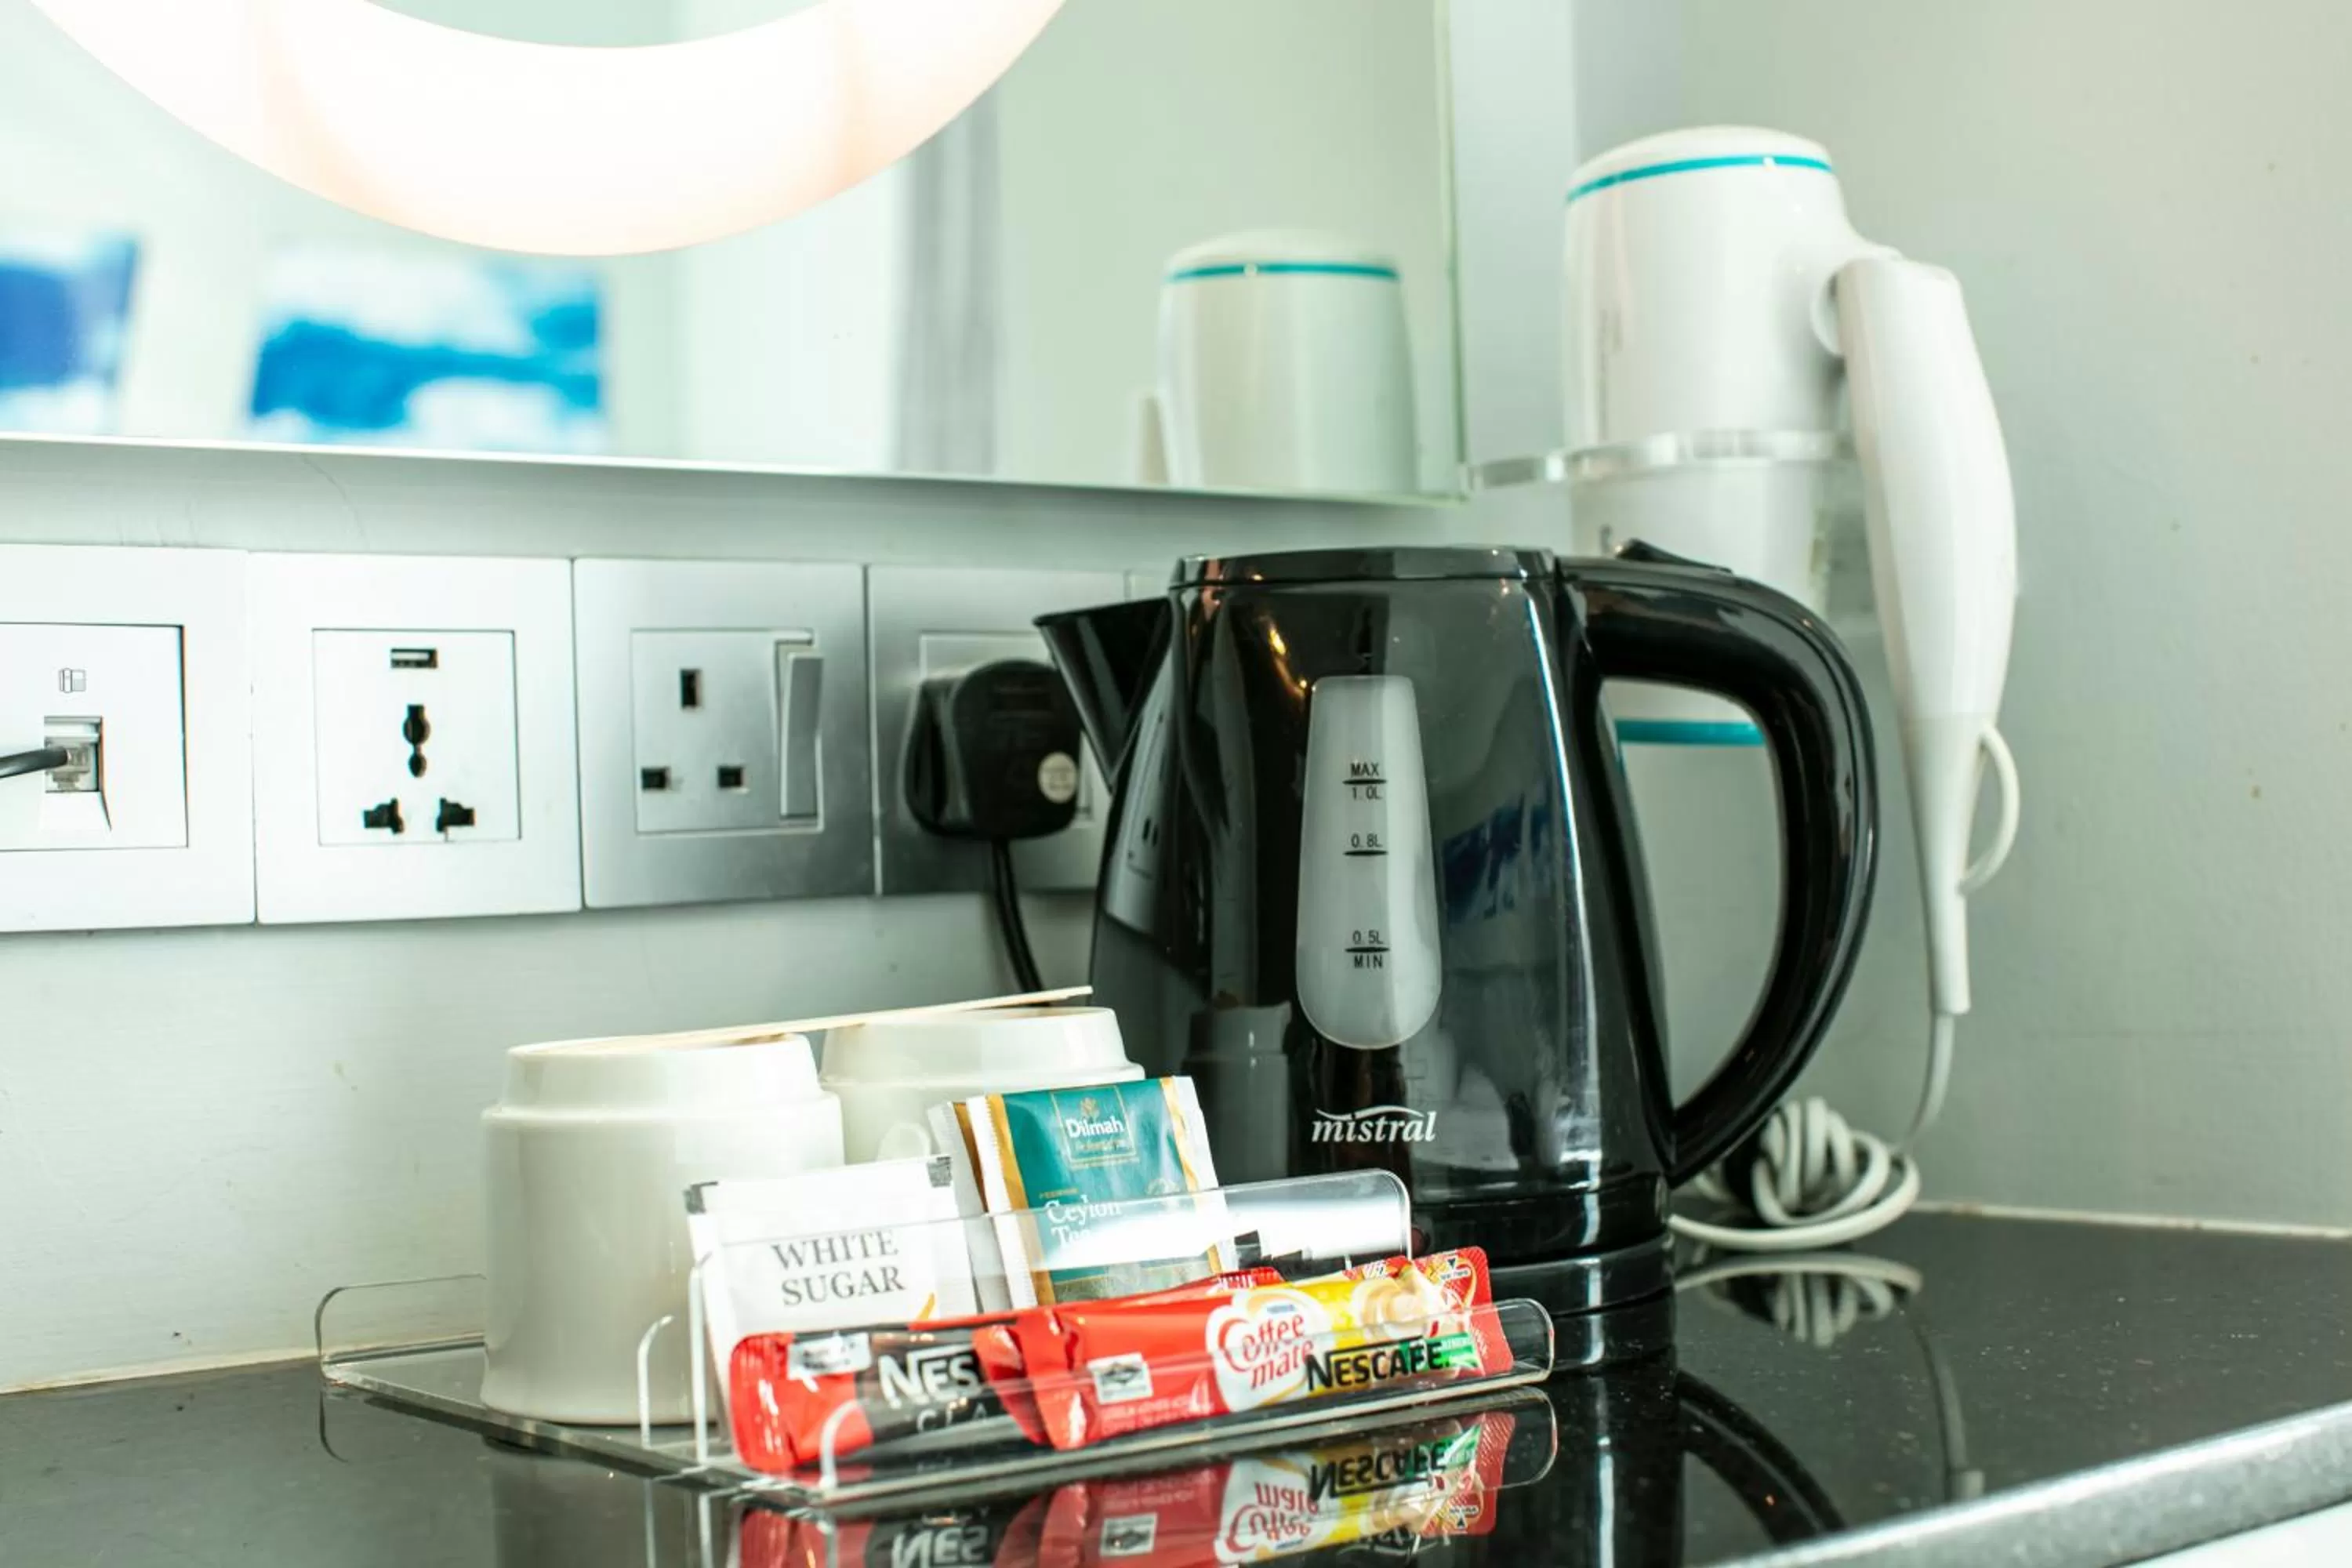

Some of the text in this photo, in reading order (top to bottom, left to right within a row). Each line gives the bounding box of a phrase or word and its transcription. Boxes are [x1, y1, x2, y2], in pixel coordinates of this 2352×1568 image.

[1350, 761, 1380, 777] MAX
[1353, 954, 1383, 969] MIN
[1065, 1115, 1124, 1139] Dilmah
[1312, 1105, 1436, 1143] mistral
[1044, 1194, 1122, 1226] Ceylon
[771, 1229, 899, 1271] WHITE
[781, 1265, 906, 1306] SUGAR
